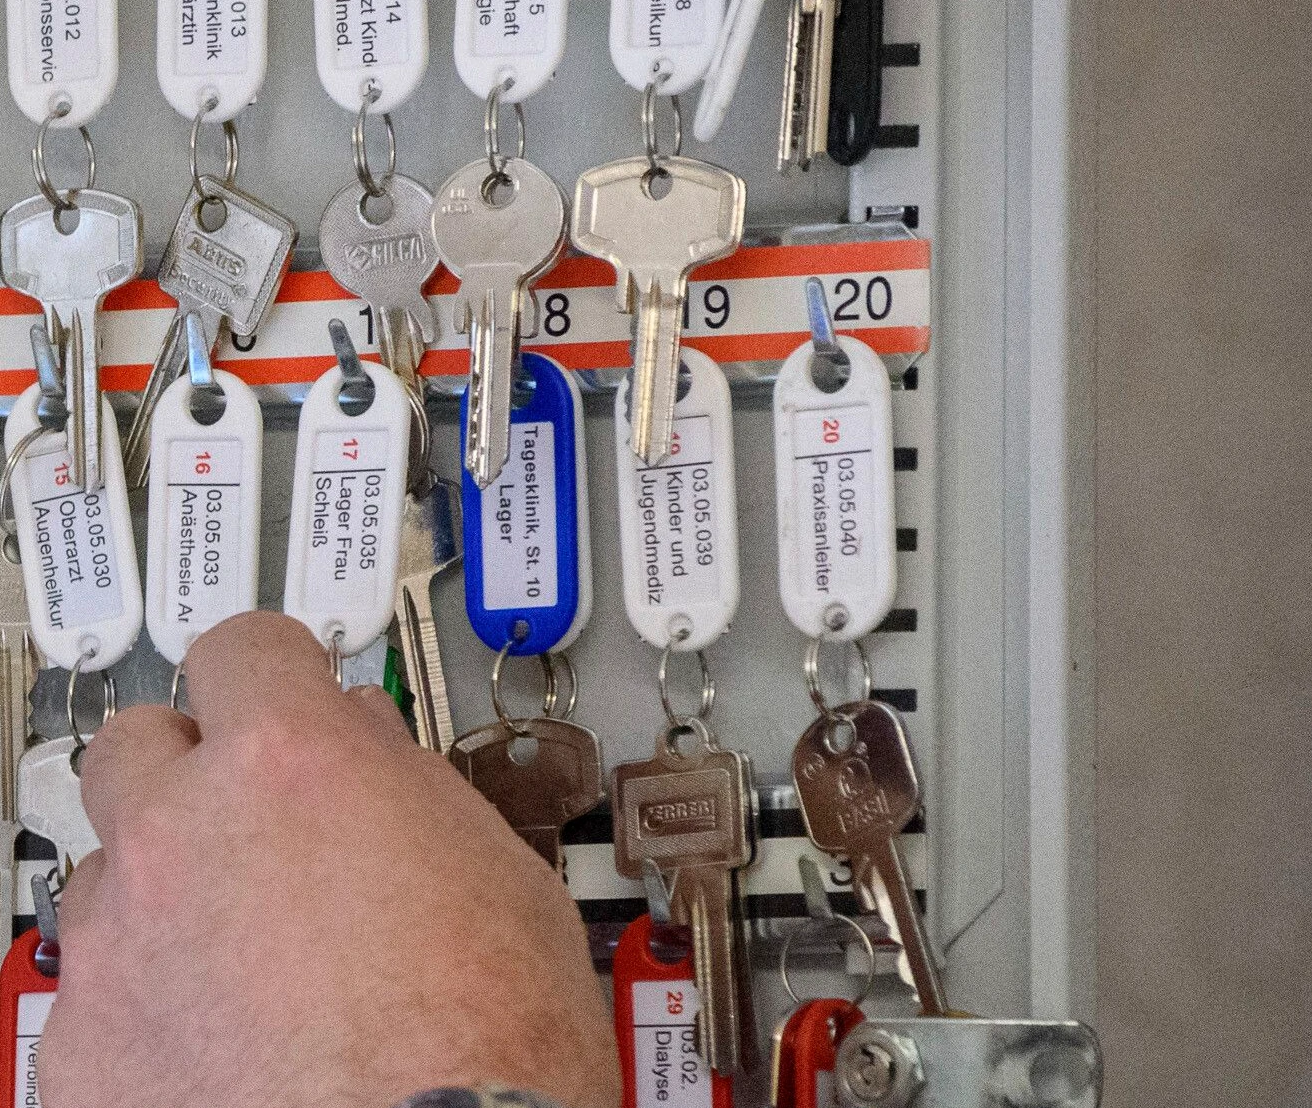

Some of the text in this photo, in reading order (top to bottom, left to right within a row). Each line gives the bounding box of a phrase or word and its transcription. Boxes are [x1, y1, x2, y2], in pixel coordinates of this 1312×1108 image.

[834, 275, 892, 320] 20
[195, 451, 211, 475] 16
[343, 438, 359, 461] 17
[824, 420, 838, 443] 20
[53, 462, 70, 485] 15
[313, 477, 331, 548] Schleiß
[497, 483, 513, 544] Lager
[521, 426, 539, 539] Tagesklinik,
[837, 458, 858, 556] 03.05.040
[59, 500, 84, 582] Oberarzt
[84, 494, 111, 588] 03.05.030
[177, 490, 198, 596] Anästhesie
[203, 489, 221, 586] 03.05.033
[335, 476, 355, 581] Lager Frau
[359, 474, 381, 569] 03.05.035
[666, 471, 688, 576] Kinder und
[692, 468, 713, 566] 03.05.039
[813, 461, 830, 593] Praxisanleiter
[526, 580, 540, 597] 10
[667, 992, 682, 1015] 29
[654, 1031, 672, 1101] Dialyse
